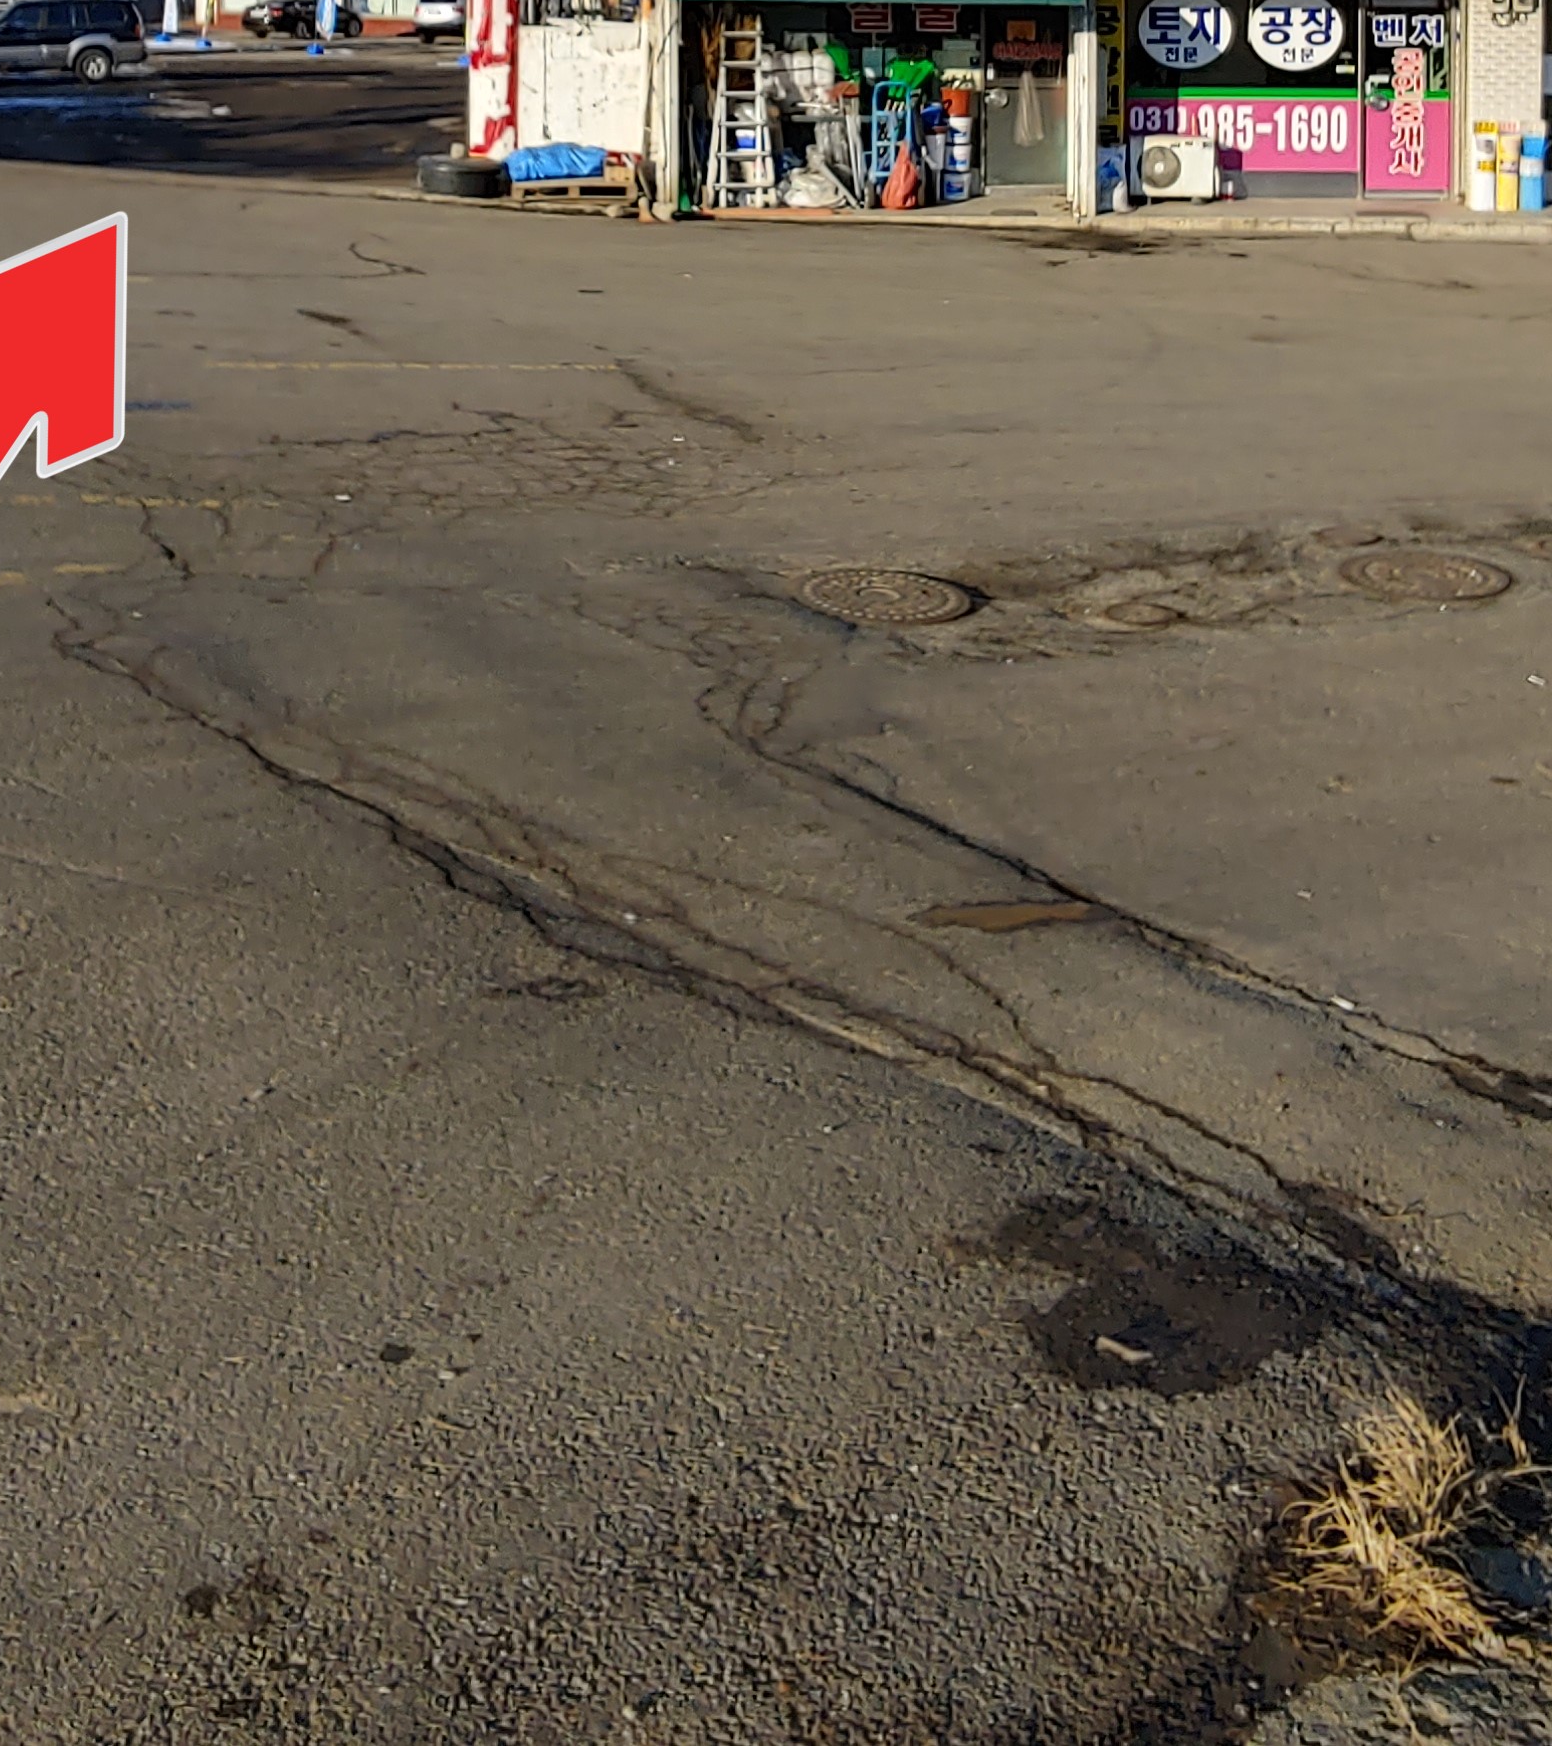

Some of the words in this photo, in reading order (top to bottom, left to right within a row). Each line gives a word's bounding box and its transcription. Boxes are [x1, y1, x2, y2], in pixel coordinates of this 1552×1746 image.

[1146, 6, 1222, 45] 토지
[1259, 6, 1335, 45] 공장
[1165, 47, 1198, 63] 전문
[1282, 46, 1315, 63] 전문
[1197, 104, 1348, 153] 985-1690
